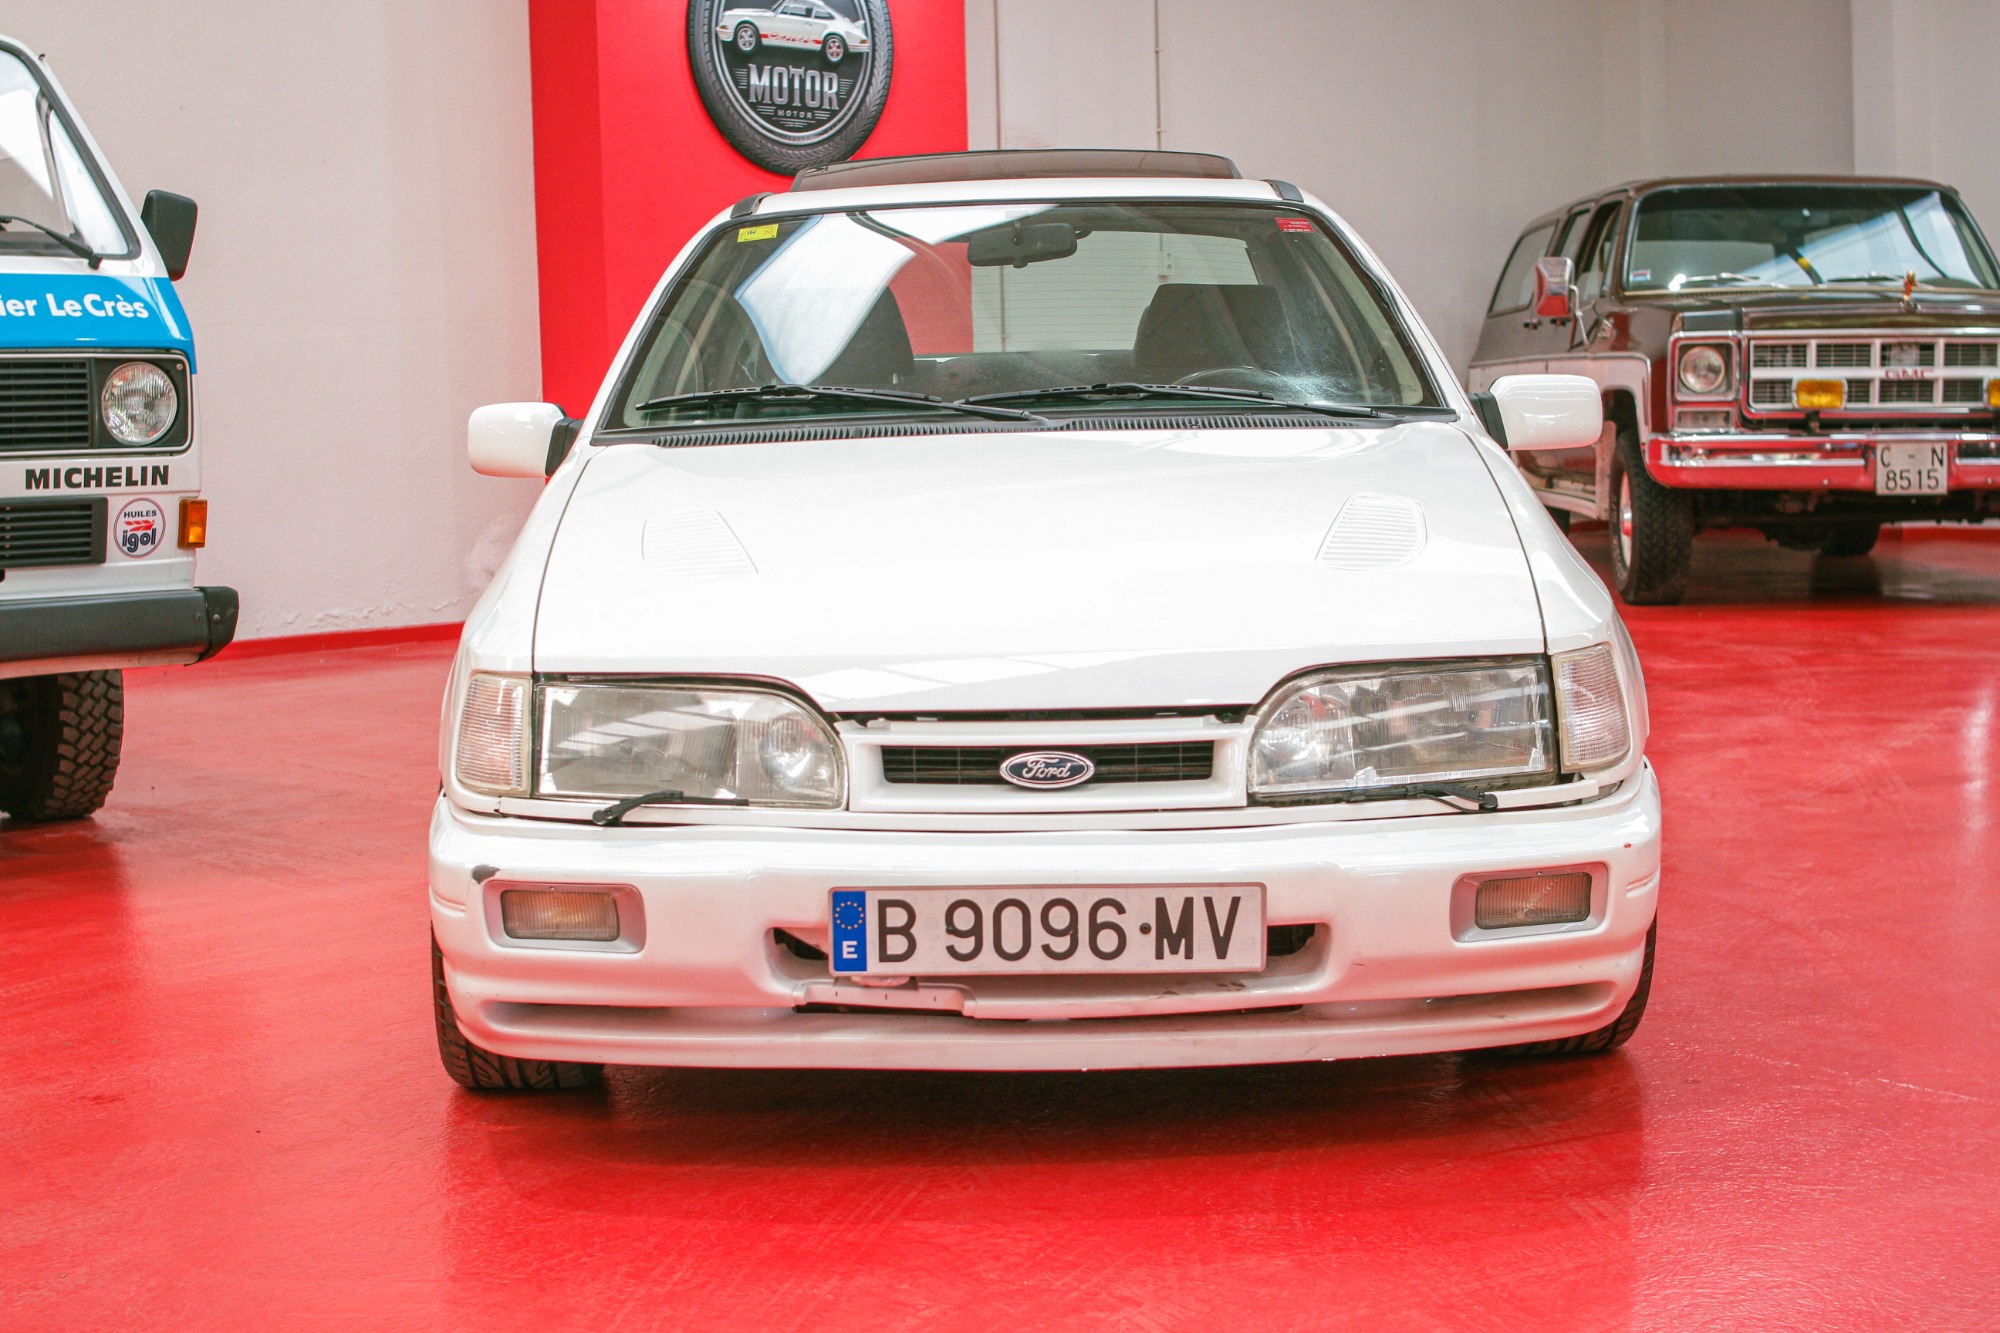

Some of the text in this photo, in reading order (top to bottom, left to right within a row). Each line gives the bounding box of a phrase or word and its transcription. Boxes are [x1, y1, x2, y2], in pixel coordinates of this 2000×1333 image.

[748, 63, 839, 110] MOTOR
[777, 109, 813, 119] MOTOR
[45, 293, 83, 317] Le
[83, 293, 149, 318] Crès
[1881, 446, 1891, 467] C
[1931, 446, 1944, 467] N
[25, 464, 169, 490] MICHELIN
[1886, 468, 1939, 491] 8515
[124, 510, 157, 518] HUILES
[122, 528, 157, 553] igol
[1022, 758, 1071, 778] Ford
[878, 898, 917, 963] B
[945, 897, 1127, 962] 9096
[842, 940, 858, 959] E
